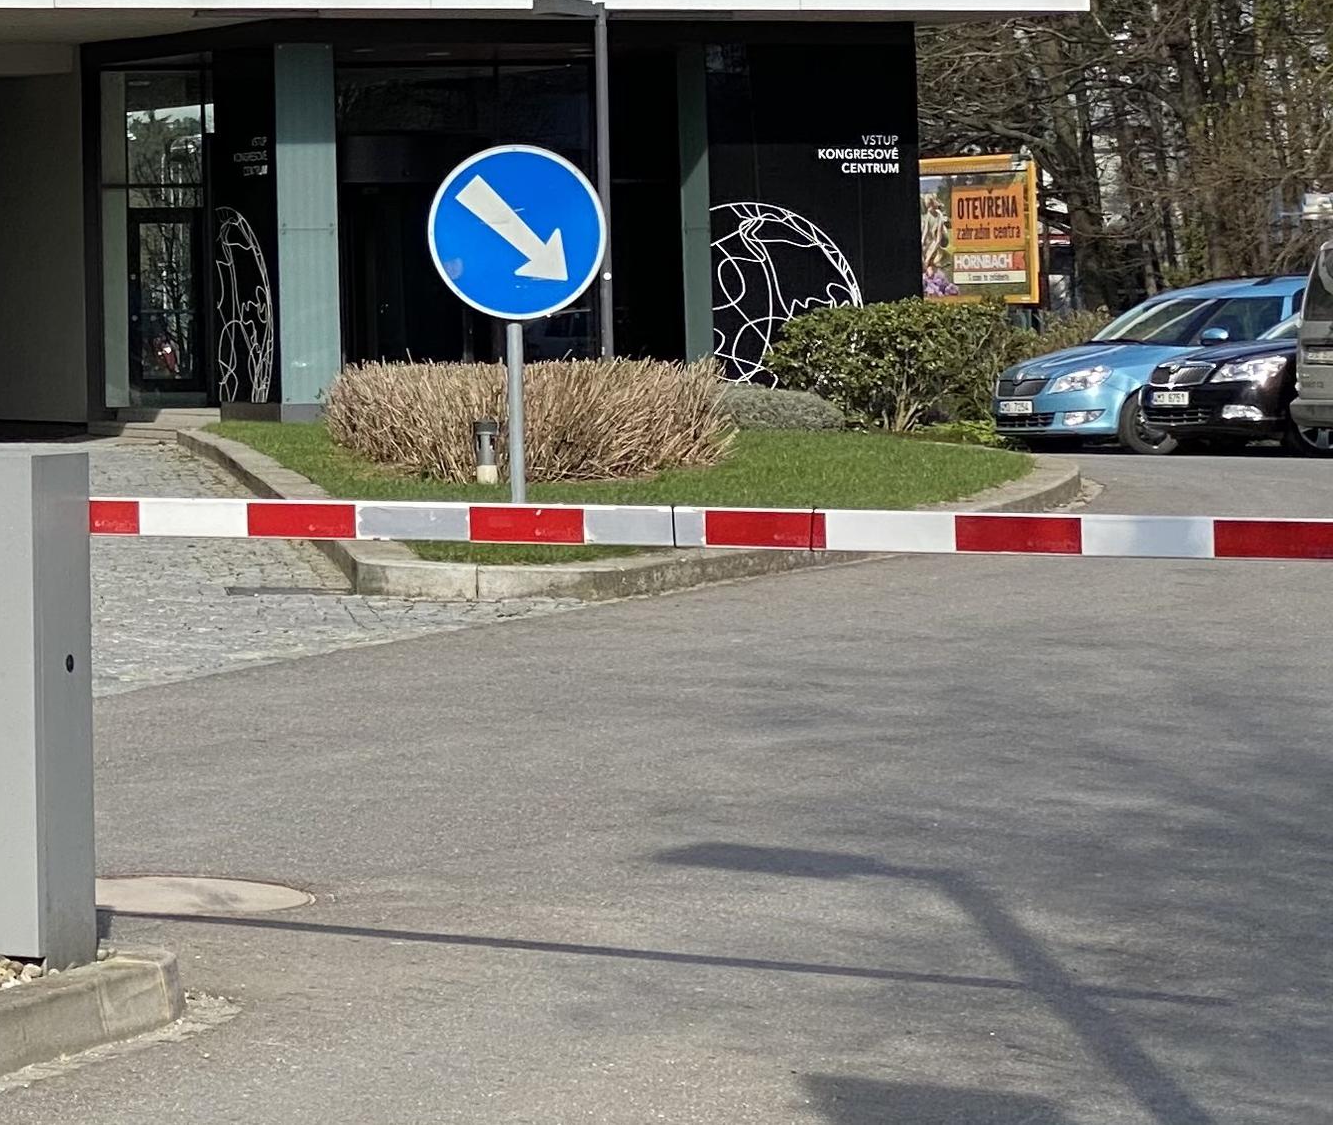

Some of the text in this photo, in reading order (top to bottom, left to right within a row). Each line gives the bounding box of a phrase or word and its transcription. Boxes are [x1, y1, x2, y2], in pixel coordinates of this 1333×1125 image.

[861, 134, 899, 146] VSTUP
[817, 146, 899, 160] KONGRESOVÉ
[841, 162, 900, 174] CENTRUM
[957, 188, 1019, 220] OTEVŘENA
[954, 253, 1014, 270] HORNBACH
